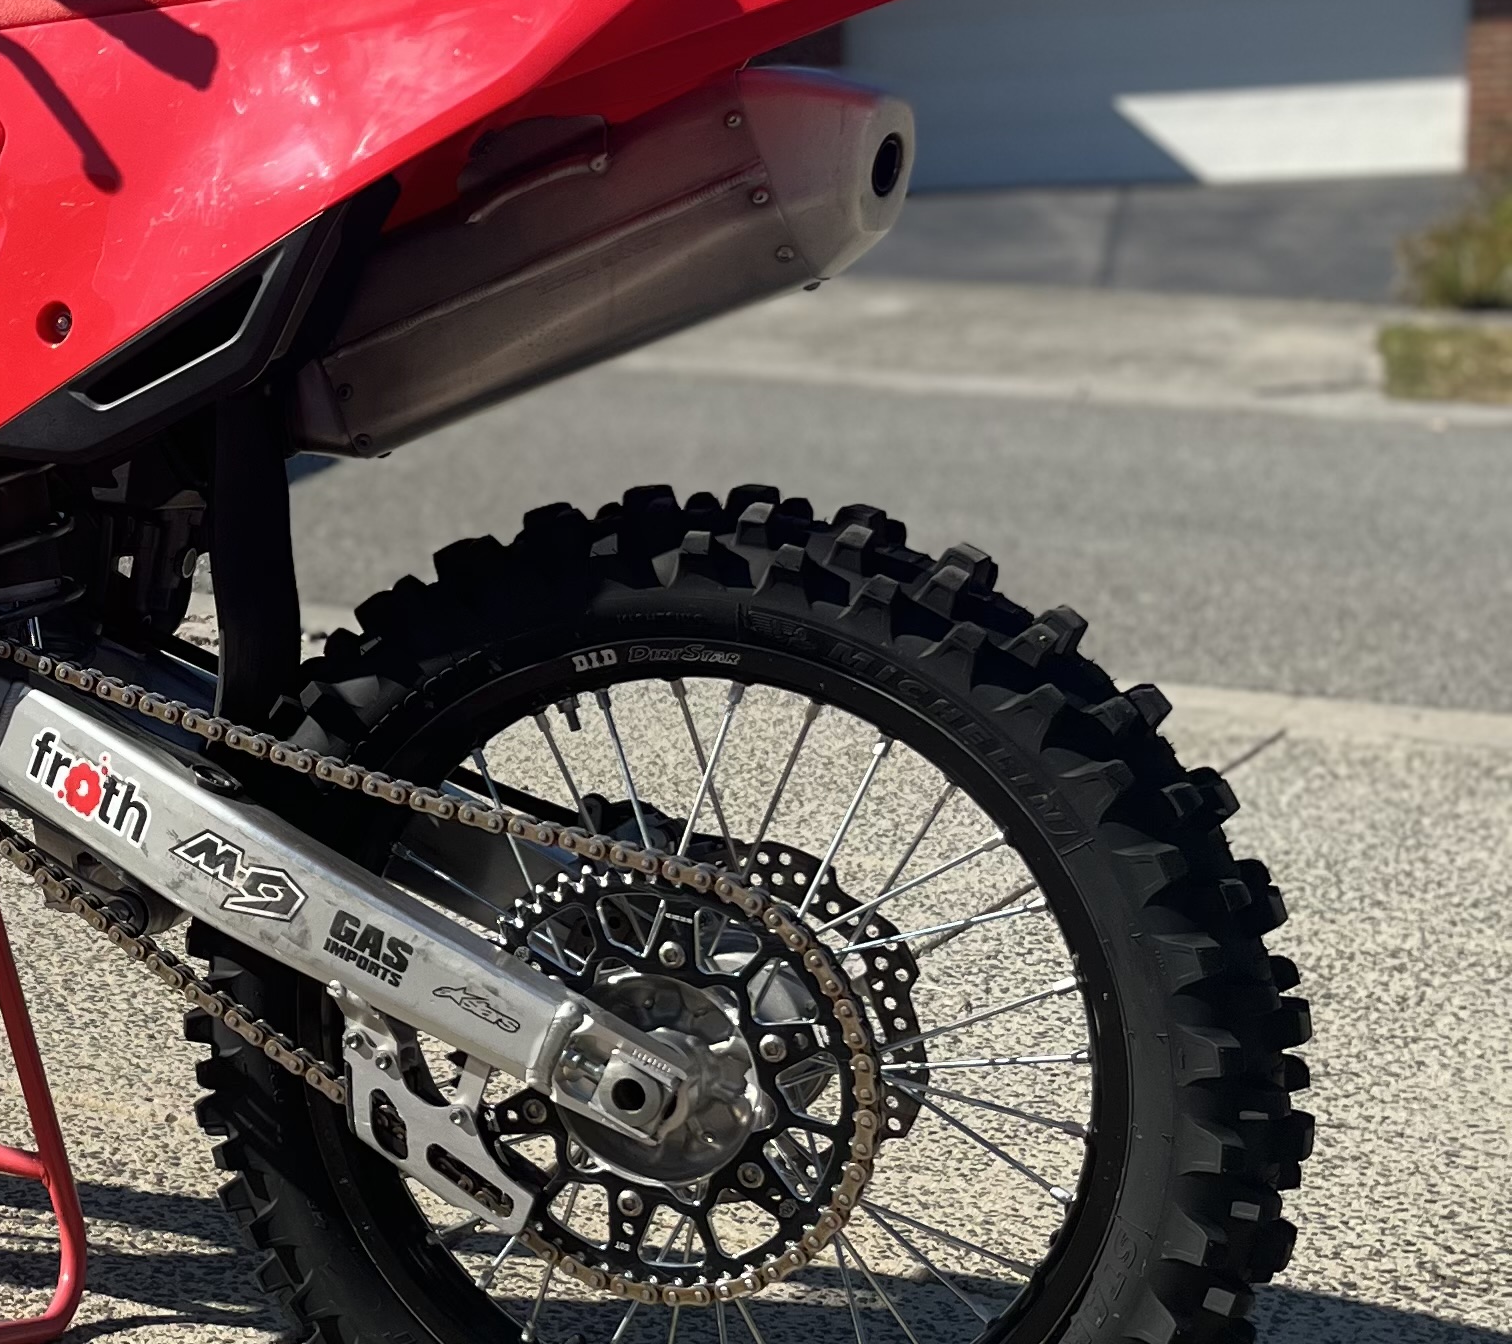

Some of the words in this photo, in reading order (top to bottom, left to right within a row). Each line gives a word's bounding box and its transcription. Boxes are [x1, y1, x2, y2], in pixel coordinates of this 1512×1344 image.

[827, 642, 1079, 834] MICHELIN
[29, 731, 148, 844] froth
[323, 937, 403, 988] IMPORTS
[329, 909, 414, 973] GAS
